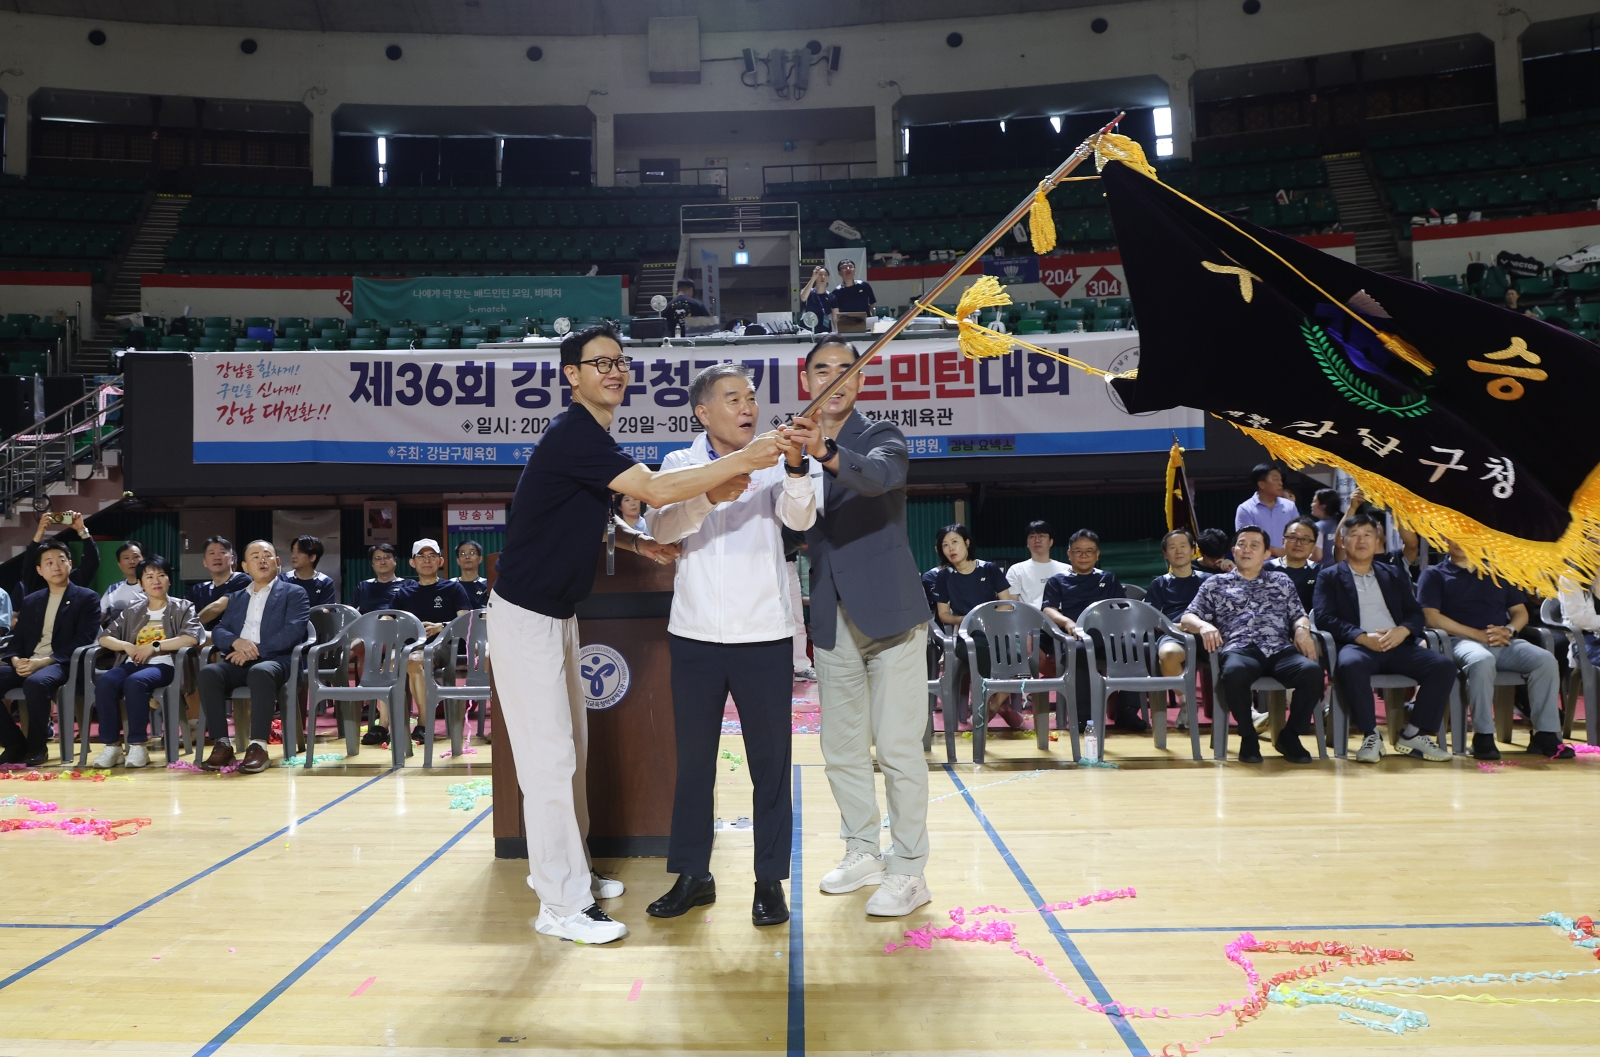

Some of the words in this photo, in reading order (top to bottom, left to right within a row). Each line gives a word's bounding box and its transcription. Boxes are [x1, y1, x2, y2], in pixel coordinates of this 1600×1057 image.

[152, 131, 158, 140] 2
[738, 239, 746, 250] 3
[1510, 260, 1538, 271] VICTOR
[1045, 268, 1075, 286] 204
[412, 288, 442, 299] 나에게
[442, 288, 452, 299] 딱
[453, 288, 471, 299] 맞는
[473, 288, 510, 299] 배드민턴
[511, 288, 533, 299] 모임,
[534, 287, 562, 299] 비매치
[1088, 279, 1119, 296] 304
[468, 304, 507, 313] b-match
[216, 361, 255, 379] 강남을
[256, 358, 301, 379] 힘차게!
[216, 382, 253, 399] 구민을
[256, 381, 302, 397] 신나게!
[349, 359, 496, 408] 제36회
[216, 402, 256, 426] 강남
[262, 400, 333, 423] 대전환!!
[476, 416, 517, 435] 일시:
[396, 445, 424, 460] 주최:
[426, 445, 497, 461] 강남구체육회
[951, 438, 974, 452] 강남
[978, 438, 1014, 451] 요넥스
